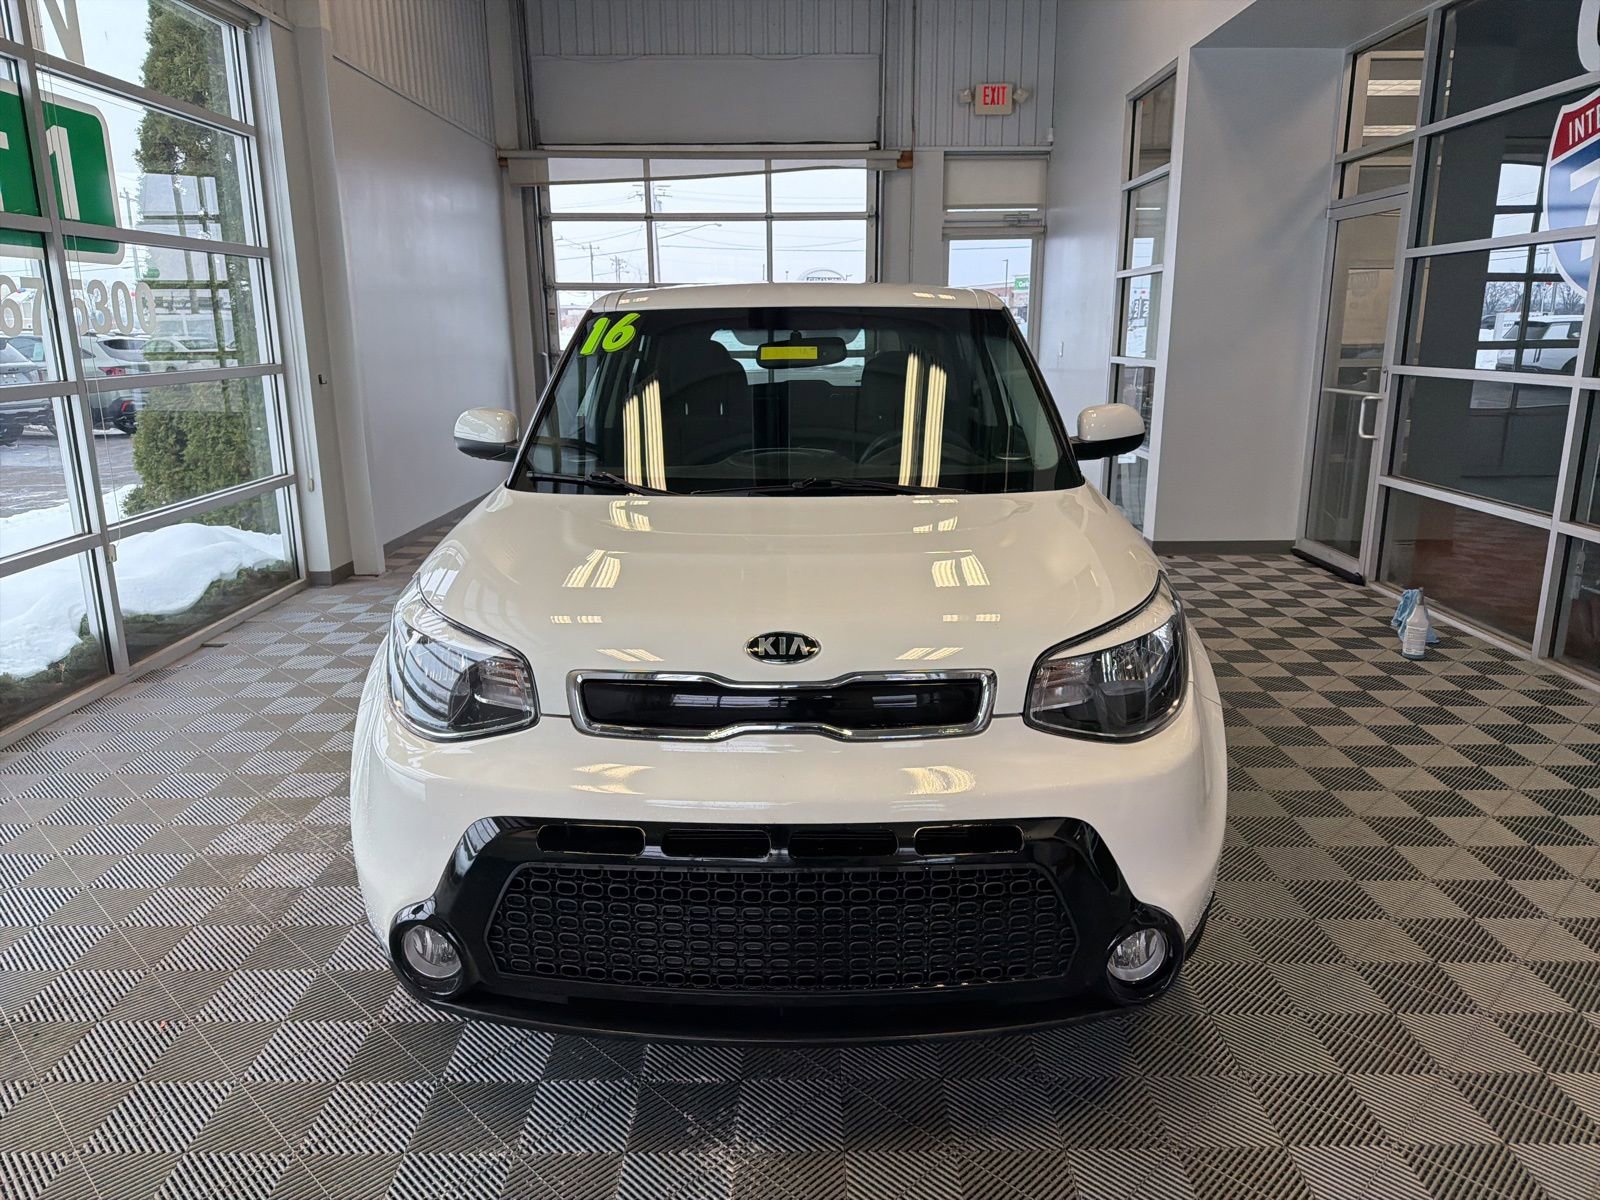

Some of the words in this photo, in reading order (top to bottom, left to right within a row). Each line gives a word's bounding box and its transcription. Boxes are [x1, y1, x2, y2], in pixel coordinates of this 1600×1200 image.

[983, 86, 1007, 105] EXIT
[580, 313, 640, 356] 16
[758, 636, 808, 656] KIA
